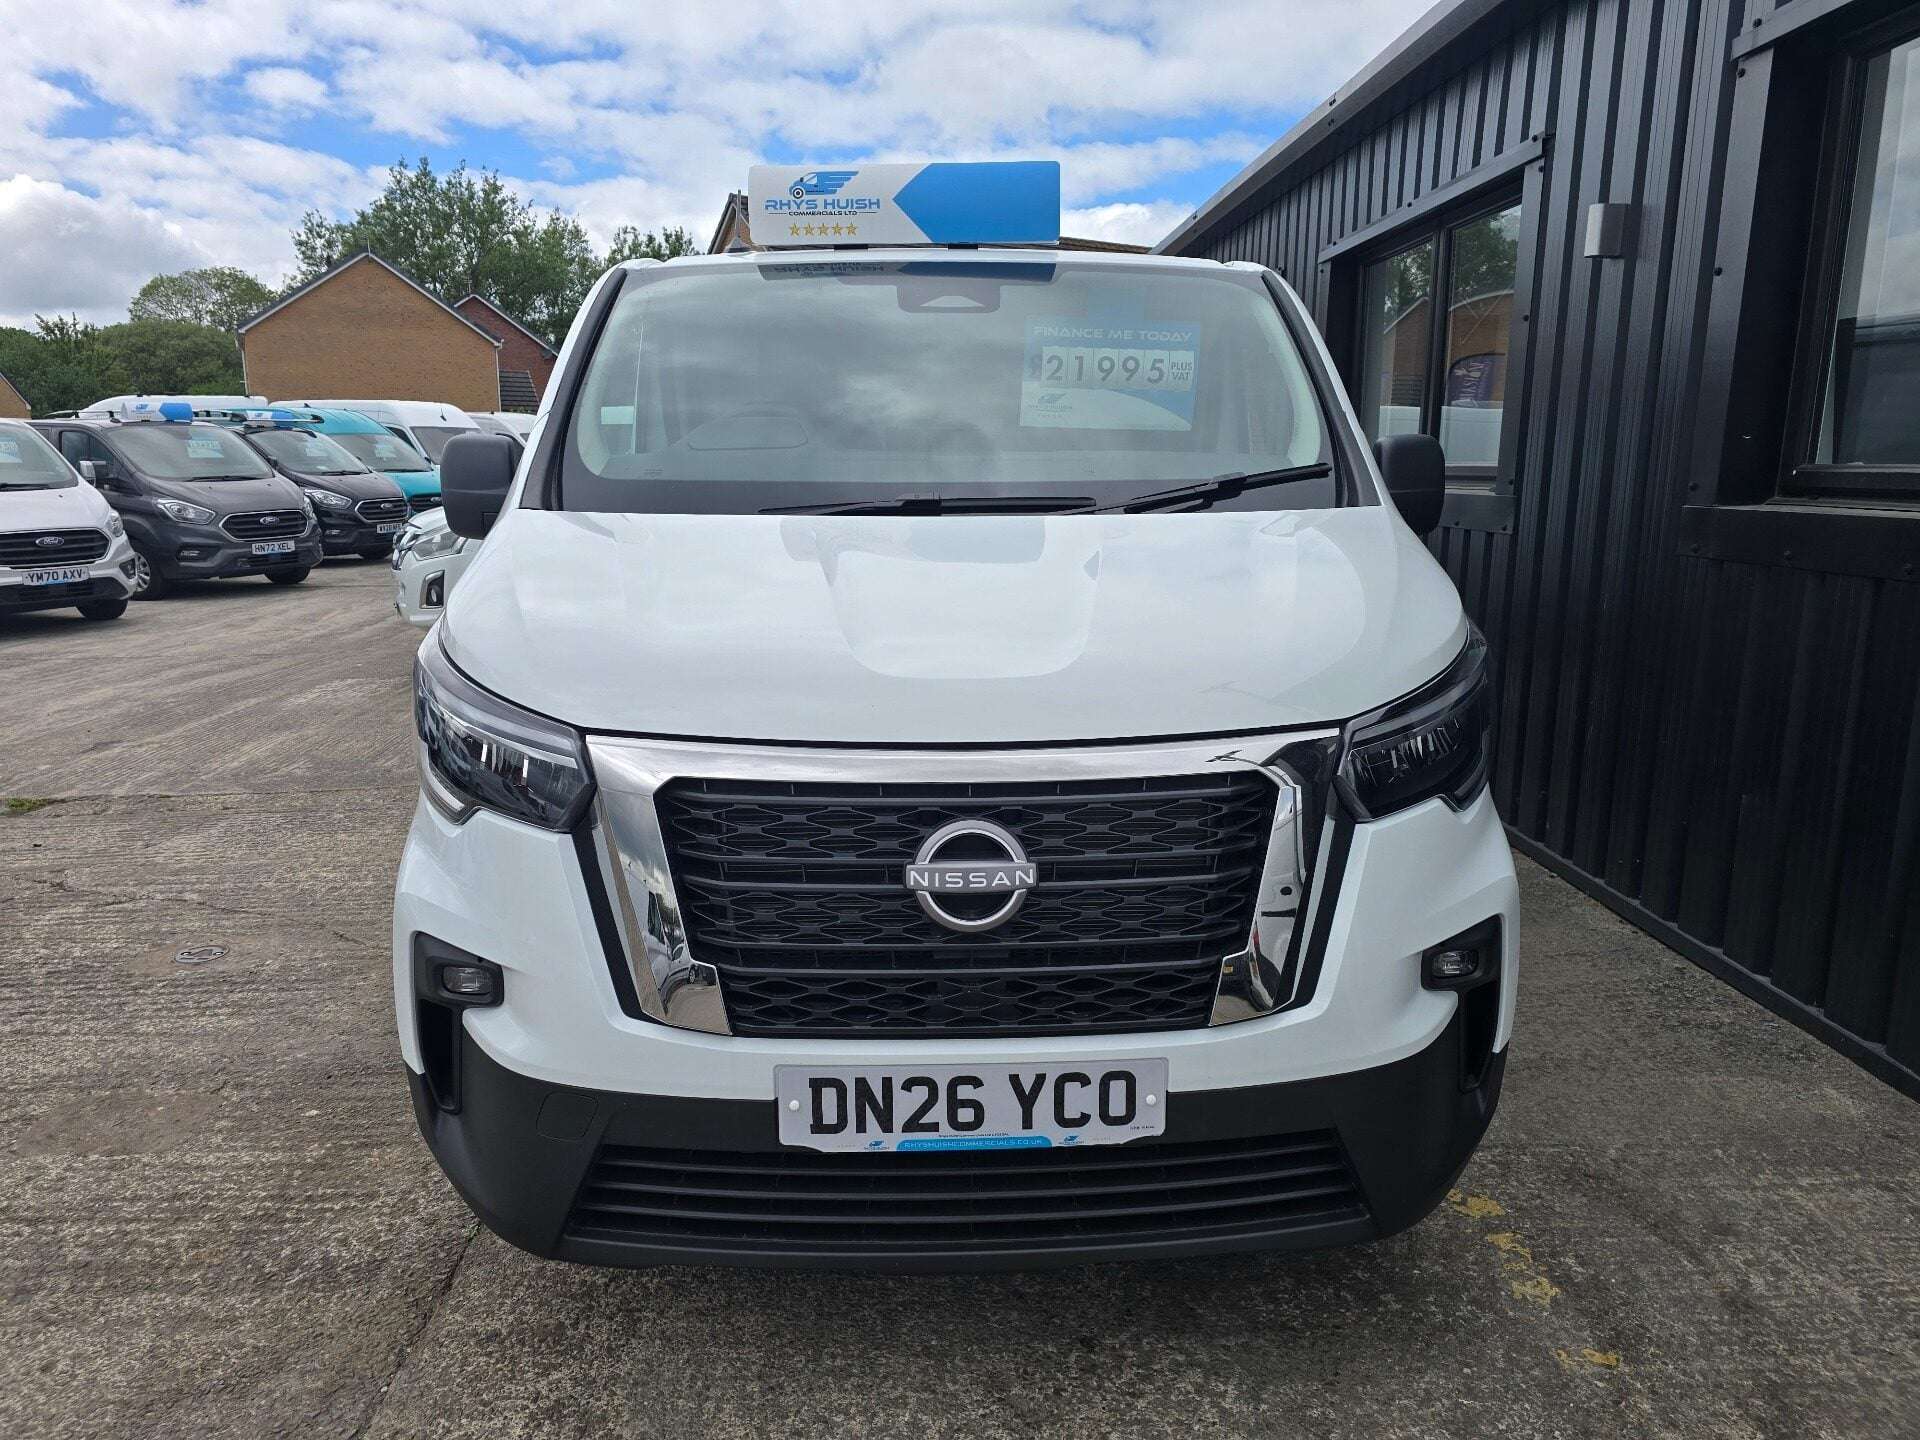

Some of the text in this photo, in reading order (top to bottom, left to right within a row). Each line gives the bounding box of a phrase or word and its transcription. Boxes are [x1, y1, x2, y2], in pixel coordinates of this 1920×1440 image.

[765, 198, 881, 210] RHYS HUISH
[1032, 326, 1193, 343] FINANCE ME TODAY
[1046, 354, 1166, 384] 21995
[1171, 361, 1193, 371] PLUS
[1172, 371, 1190, 381] VAT
[254, 542, 292, 553] HN72 XEL
[28, 568, 83, 583] YM70 AXV
[910, 869, 1035, 888] NISSAN
[808, 1070, 1137, 1134] DN26 YCO
